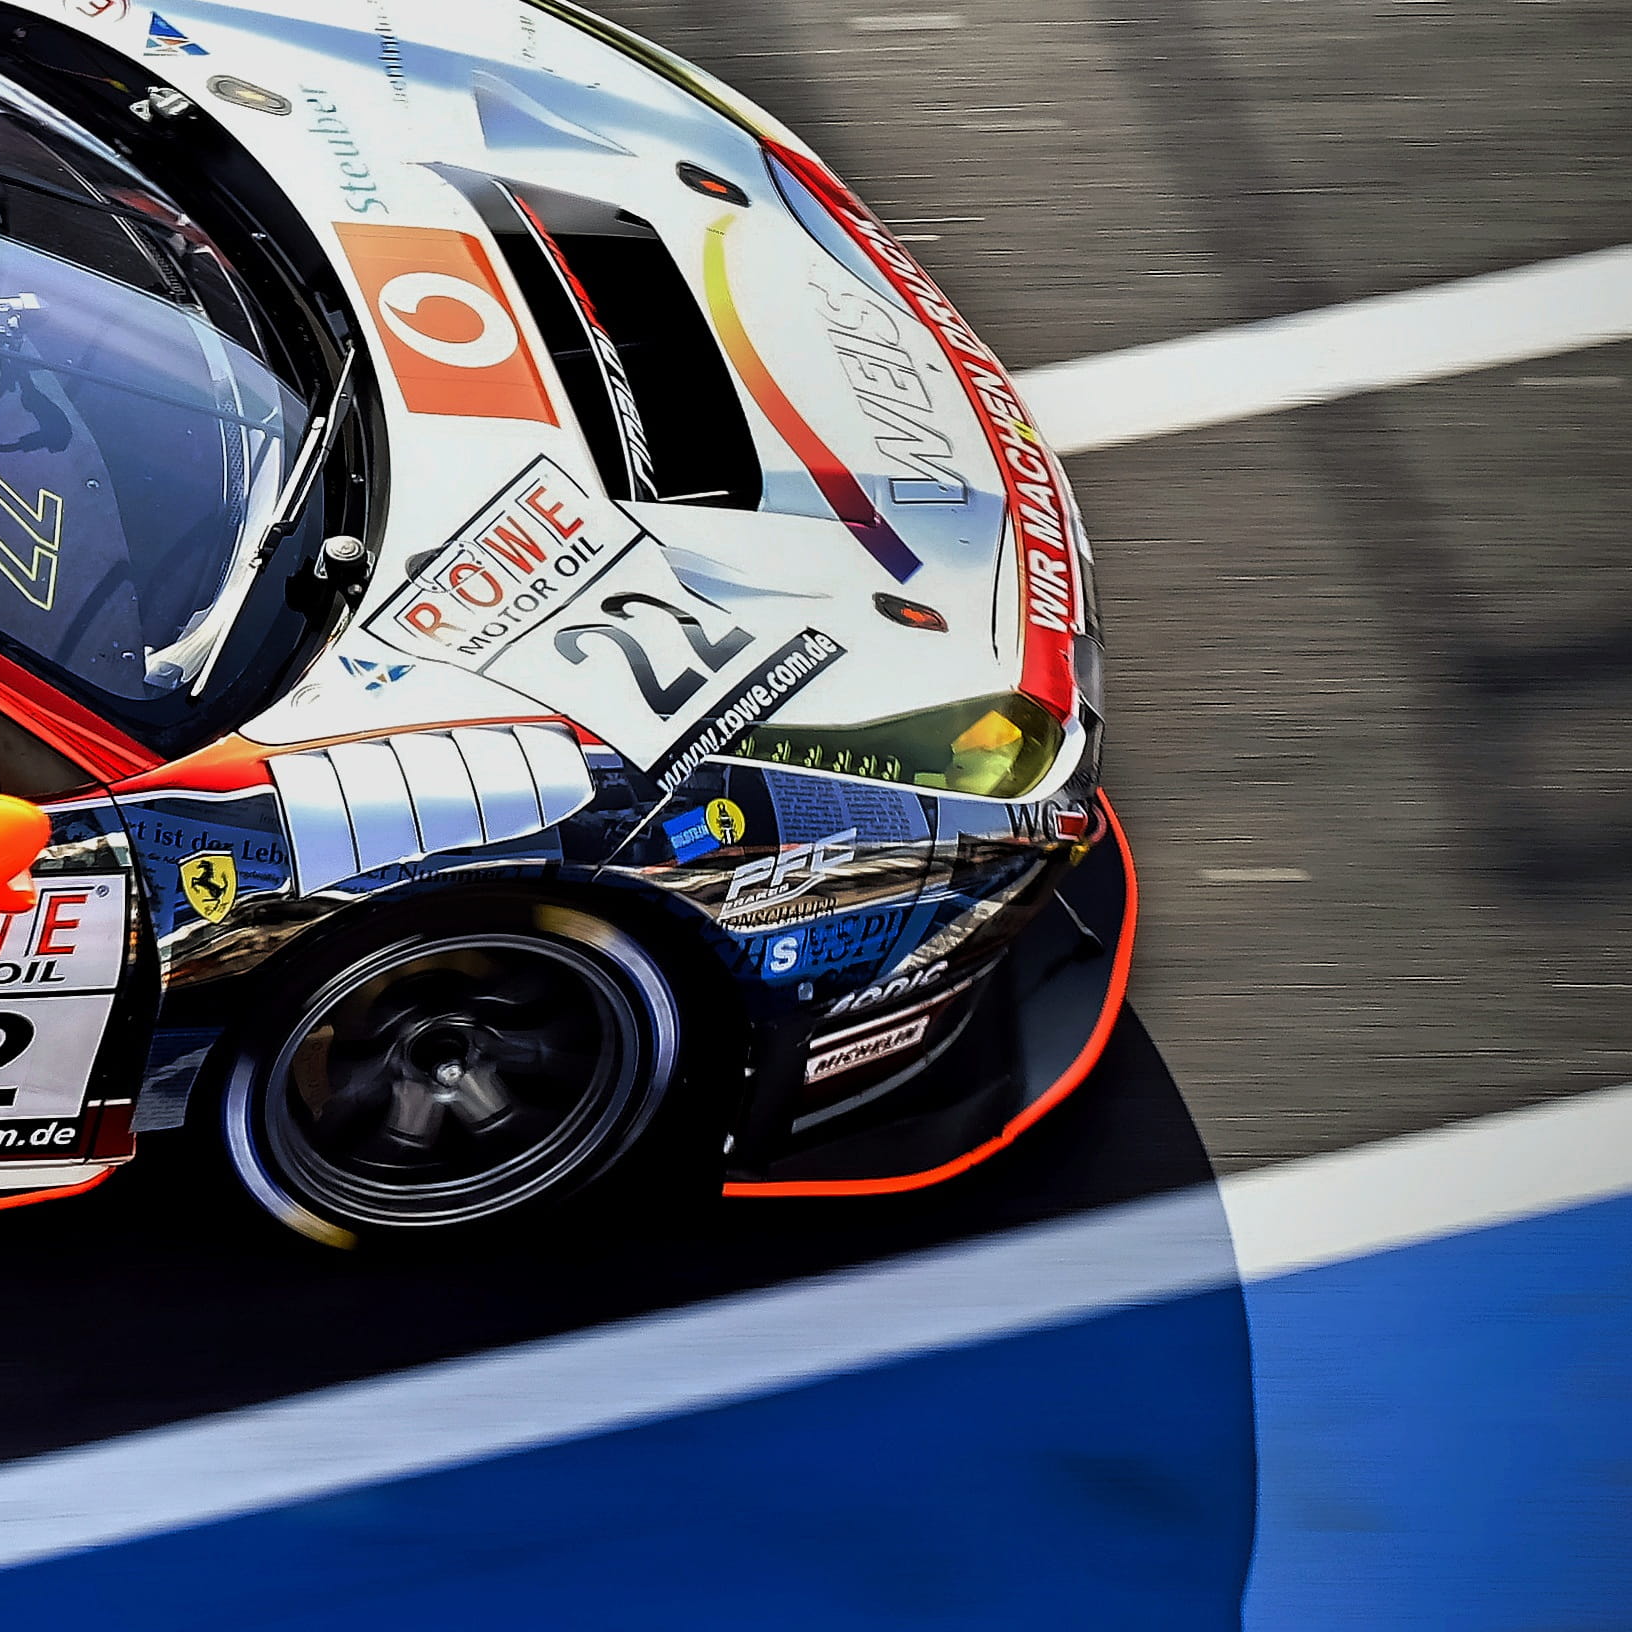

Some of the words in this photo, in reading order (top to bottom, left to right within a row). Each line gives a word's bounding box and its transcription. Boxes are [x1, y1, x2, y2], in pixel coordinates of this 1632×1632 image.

[962, 359, 1064, 549] MACHEN
[415, 485, 586, 648] ROWE
[457, 576, 557, 658] MOTOR
[554, 533, 605, 579] OIL
[1028, 549, 1074, 633] WIR
[554, 590, 755, 722] 22
[656, 629, 839, 796] www.rowe.com.de
